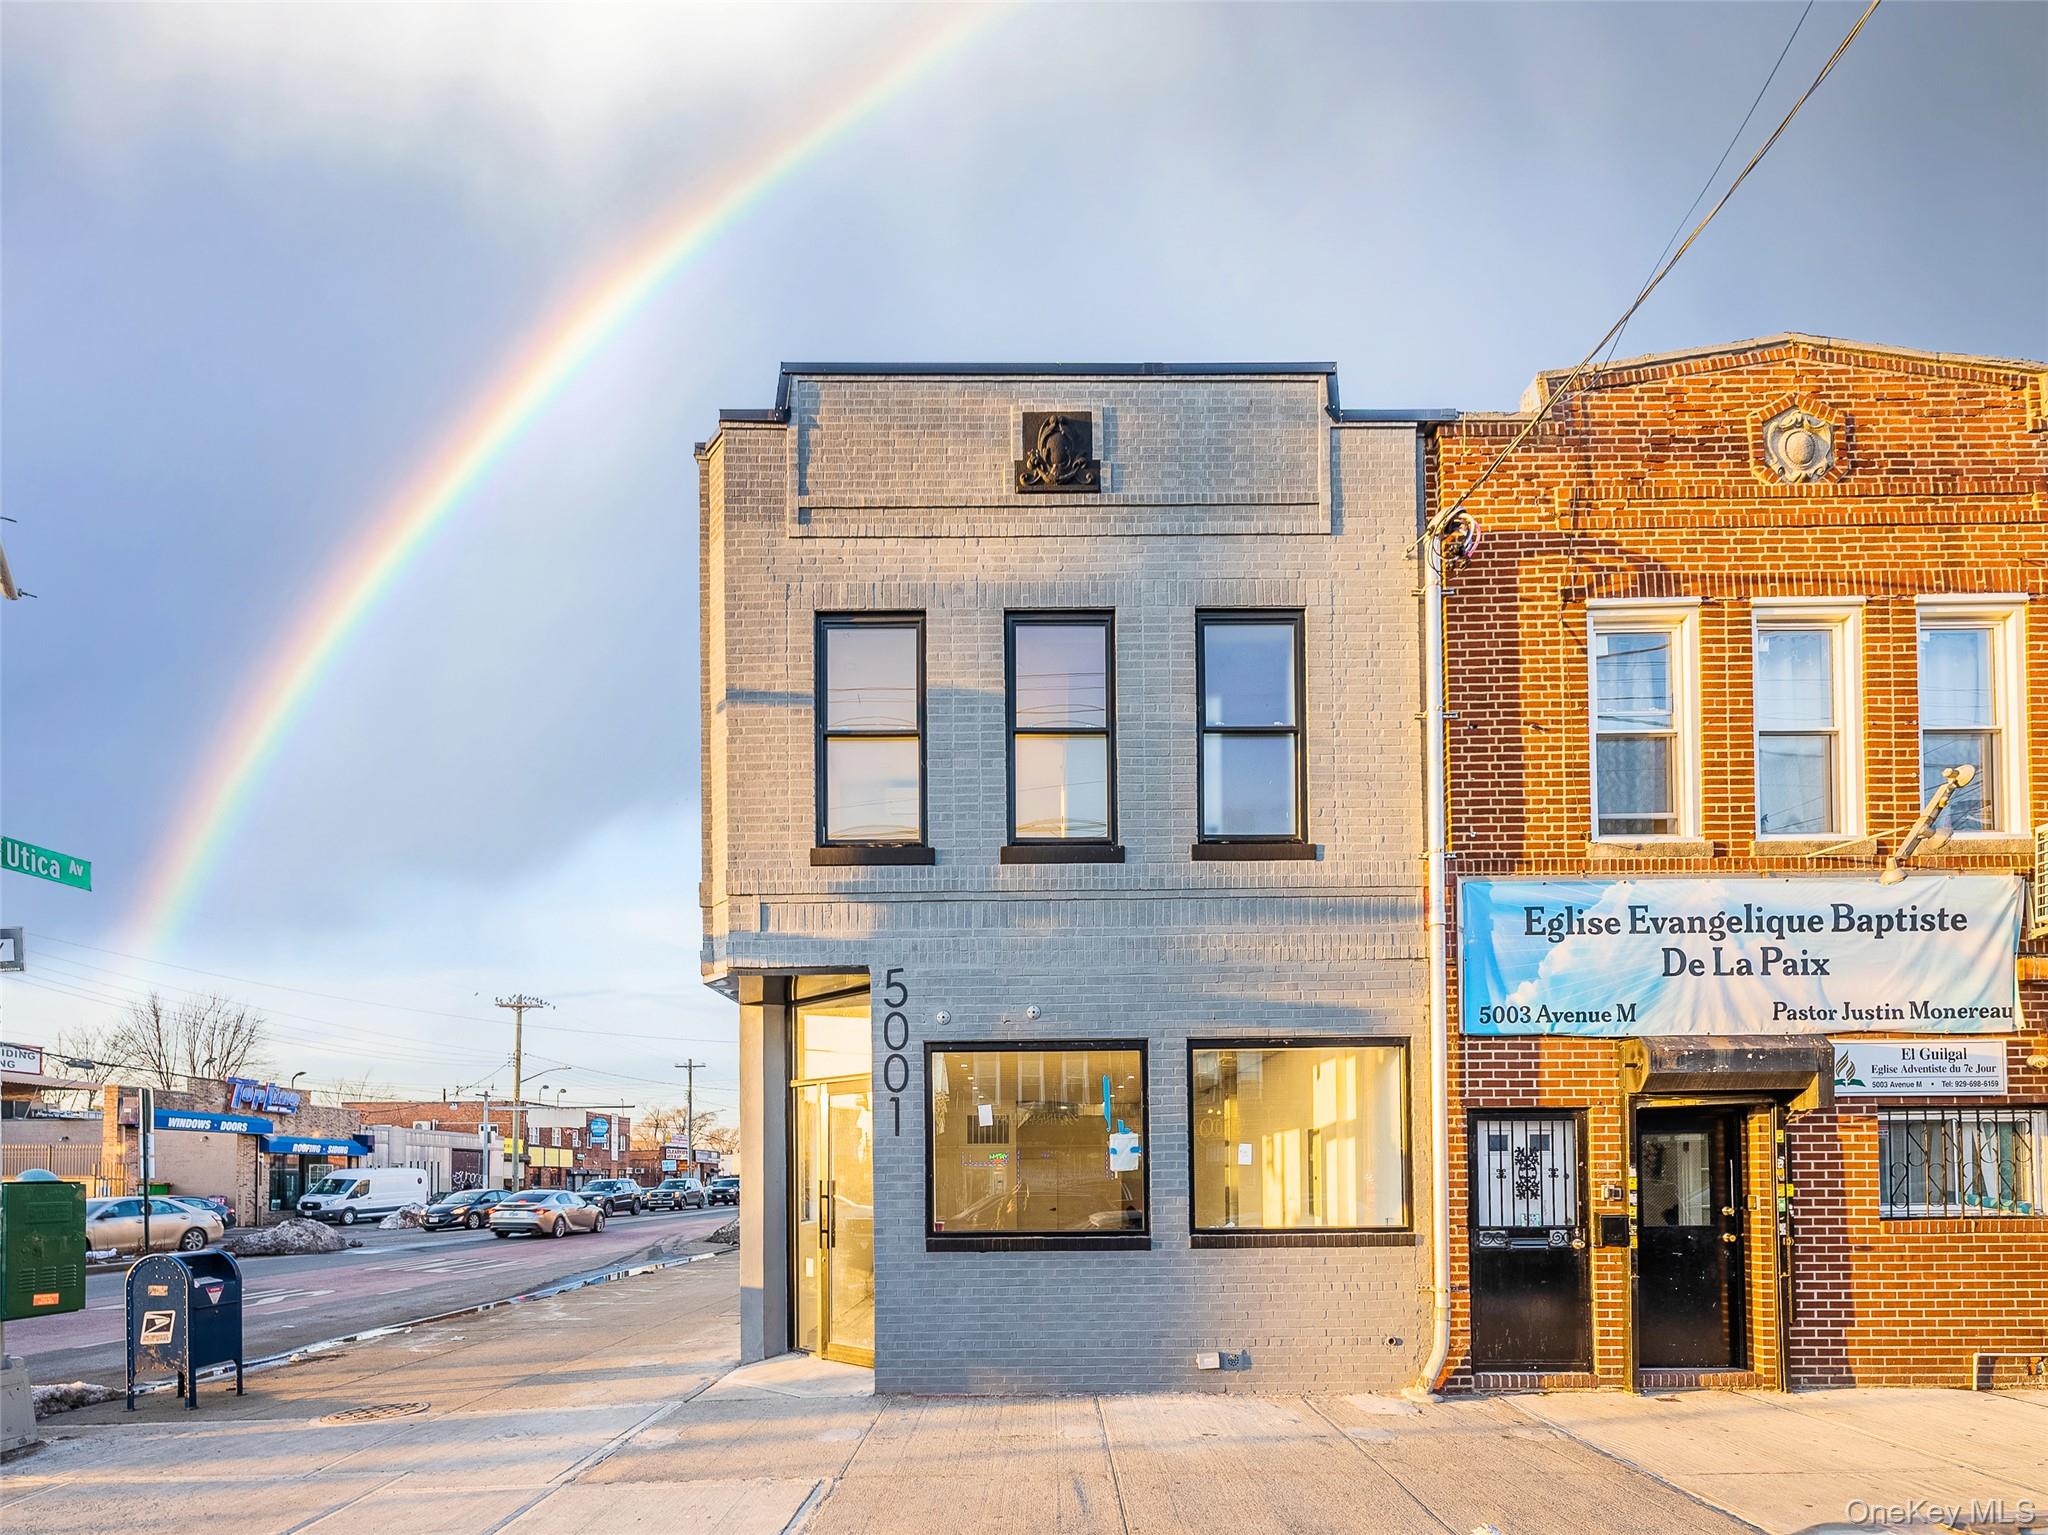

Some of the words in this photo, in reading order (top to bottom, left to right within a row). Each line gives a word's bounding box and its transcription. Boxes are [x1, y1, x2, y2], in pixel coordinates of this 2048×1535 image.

[6, 841, 60, 879] Utica
[69, 860, 83, 877] Av
[1524, 905, 1621, 943] Eglise
[1628, 903, 1824, 941] Evangelique
[1830, 903, 1968, 940] Baptiste
[1661, 947, 1705, 976] De
[1713, 947, 1754, 976] La
[1760, 946, 1830, 976] Paix
[1479, 1004, 1531, 1024] 5003
[1535, 1004, 1612, 1024] Avenue
[1616, 1003, 1637, 1023] M
[1772, 1001, 1837, 1021] Pastor
[1842, 1001, 1905, 1020] Justin
[1909, 1001, 2013, 1020] Monereau
[1901, 1047, 1915, 1061] El
[1919, 1047, 1967, 1063] Guilgal
[1871, 1064, 1898, 1076] Eglise
[1901, 1064, 1947, 1073] Adventiste
[1950, 1064, 1961, 1073] du
[1963, 1064, 1973, 1073] 7e
[1976, 1064, 1996, 1073] Jour
[1942, 1080, 1953, 1088] Tel:
[168, 1117, 211, 1129] WINDOWS
[220, 1121, 248, 1132] DOORS
[292, 1143, 321, 1153] ROOFING
[327, 1145, 349, 1154] SIDING
